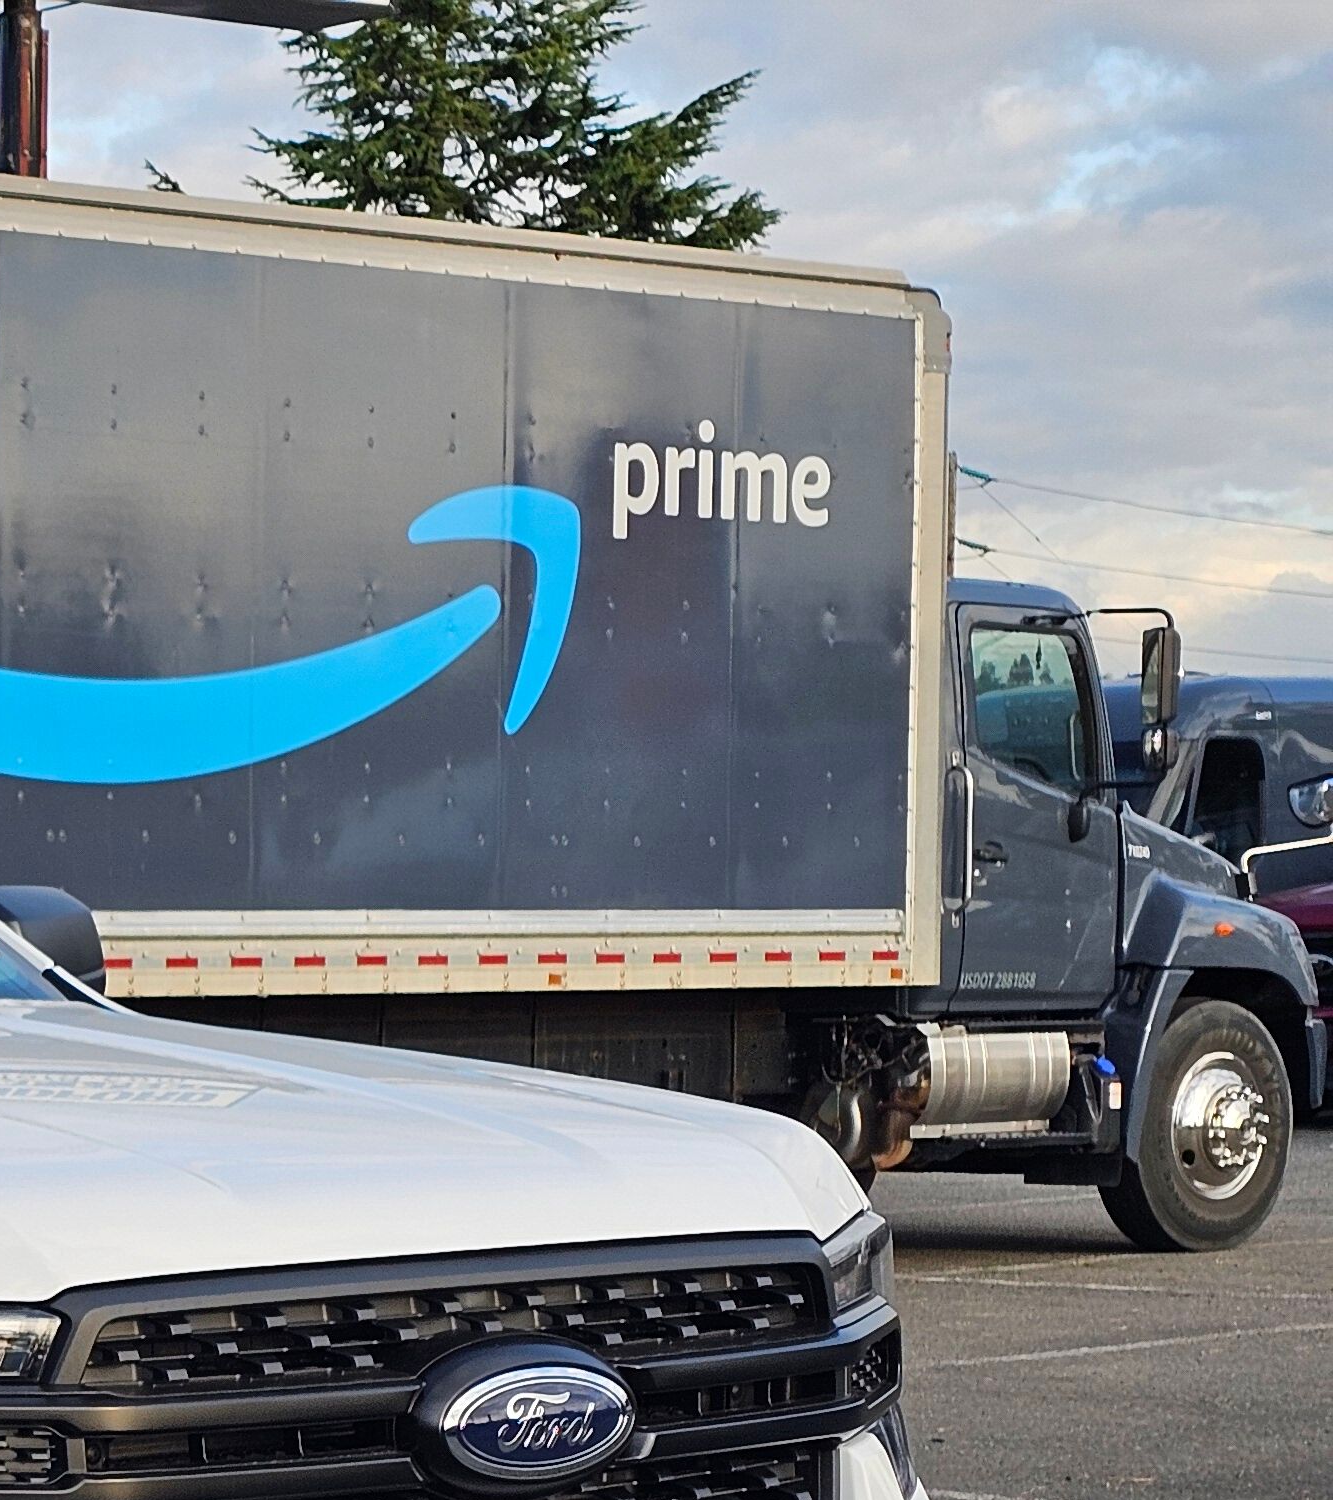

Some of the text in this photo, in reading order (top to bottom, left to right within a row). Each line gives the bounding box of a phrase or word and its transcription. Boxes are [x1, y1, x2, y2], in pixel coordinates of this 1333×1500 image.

[612, 419, 831, 540] prime
[959, 971, 994, 990] USDOT
[498, 1391, 597, 1453] Ford
